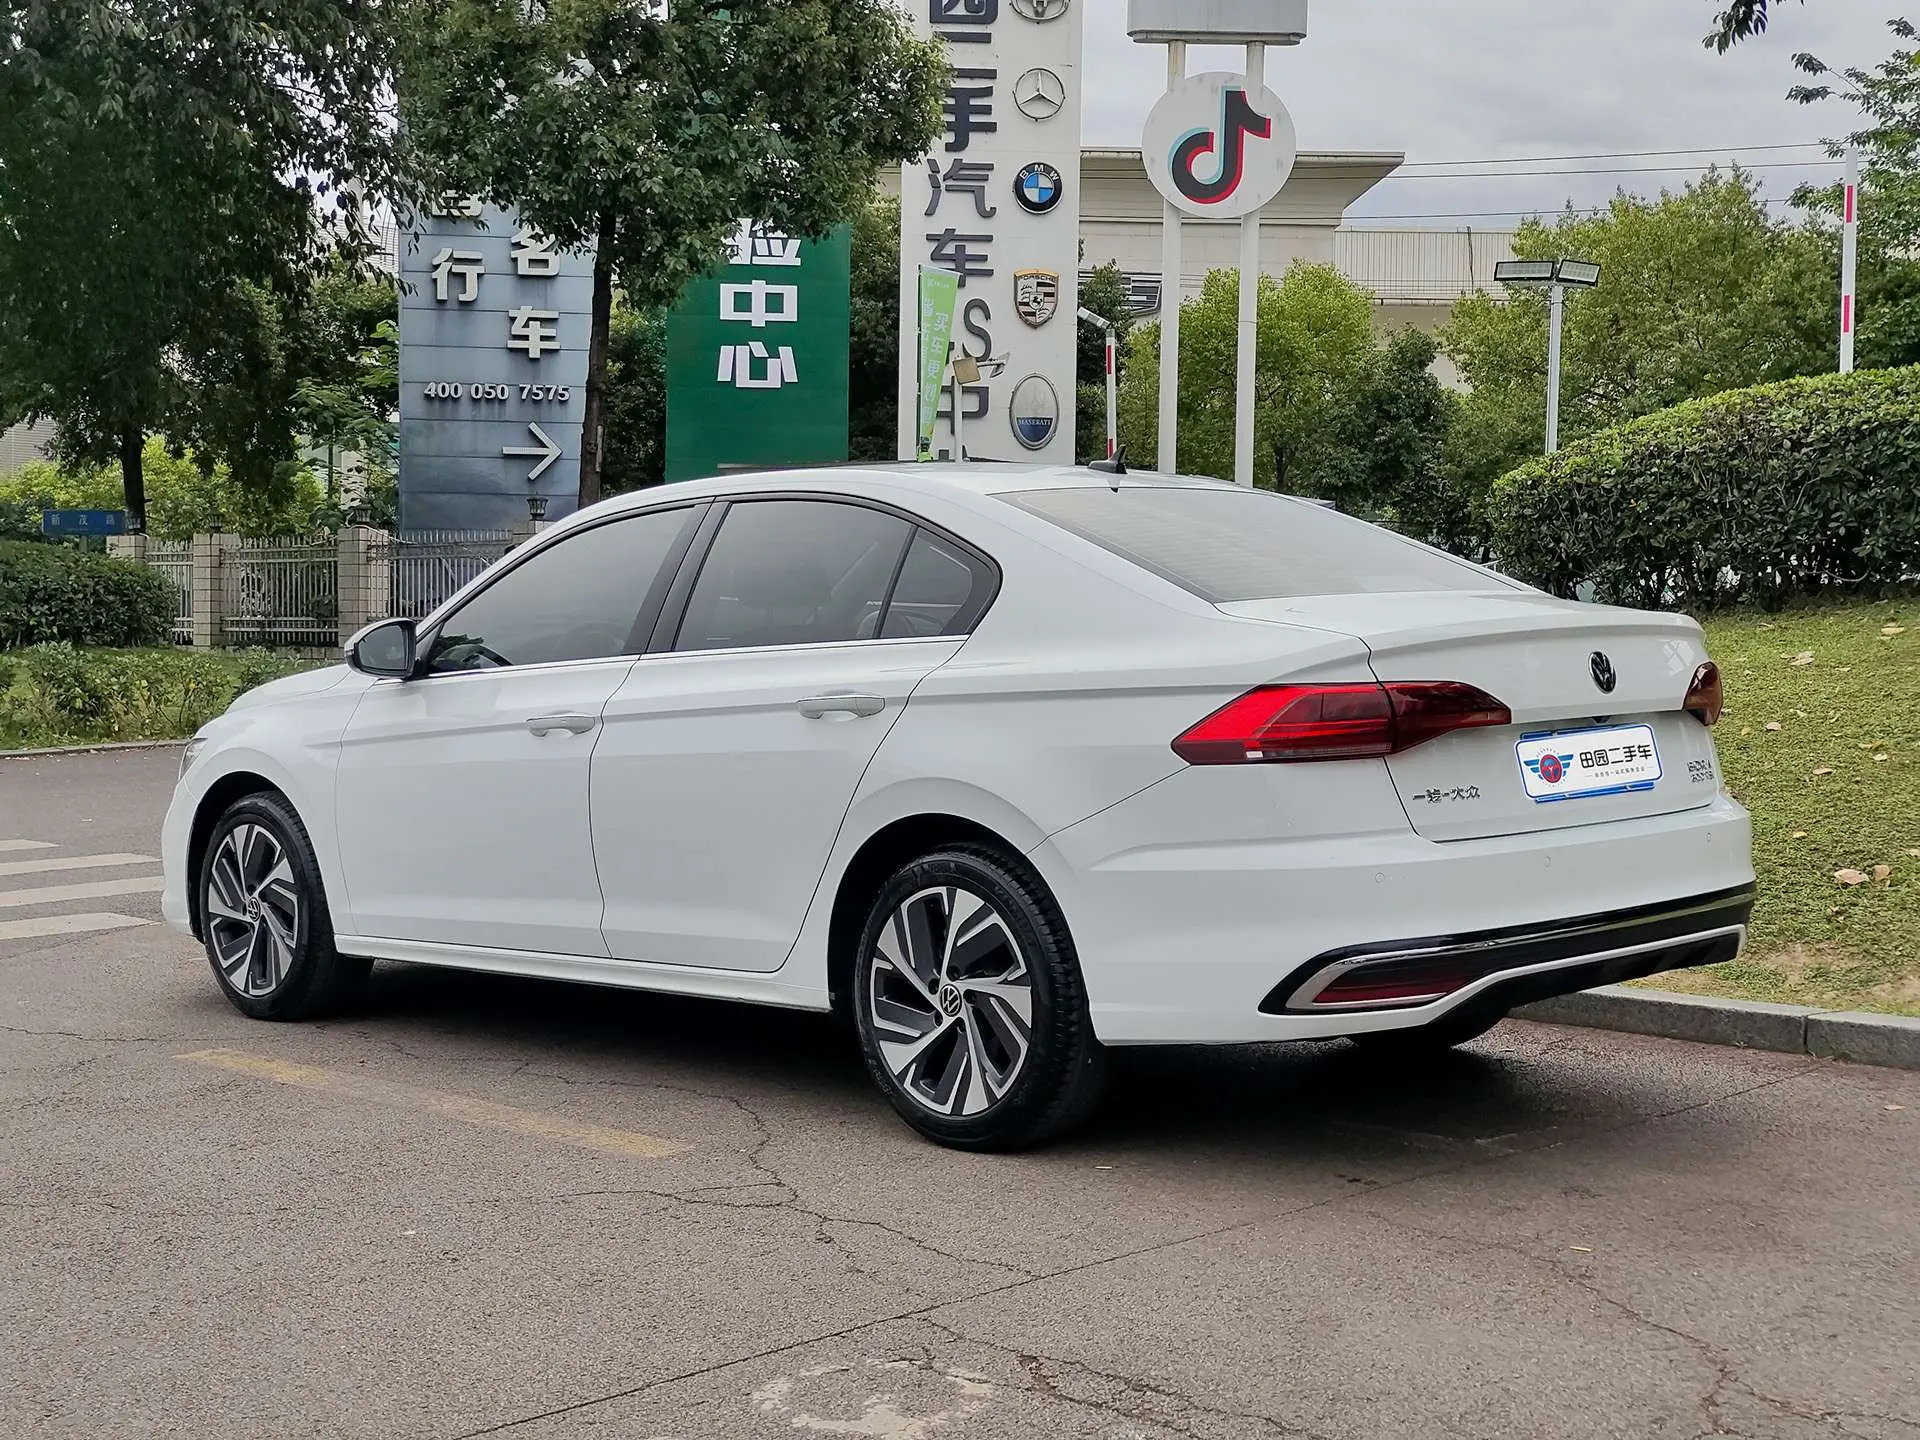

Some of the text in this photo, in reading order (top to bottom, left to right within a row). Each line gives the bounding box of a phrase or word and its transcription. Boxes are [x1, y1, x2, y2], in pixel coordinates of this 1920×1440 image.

[1020, 164, 1060, 181] BMW
[424, 382, 571, 401] 400 050 7575
[1579, 744, 1654, 769] 田园二手车
